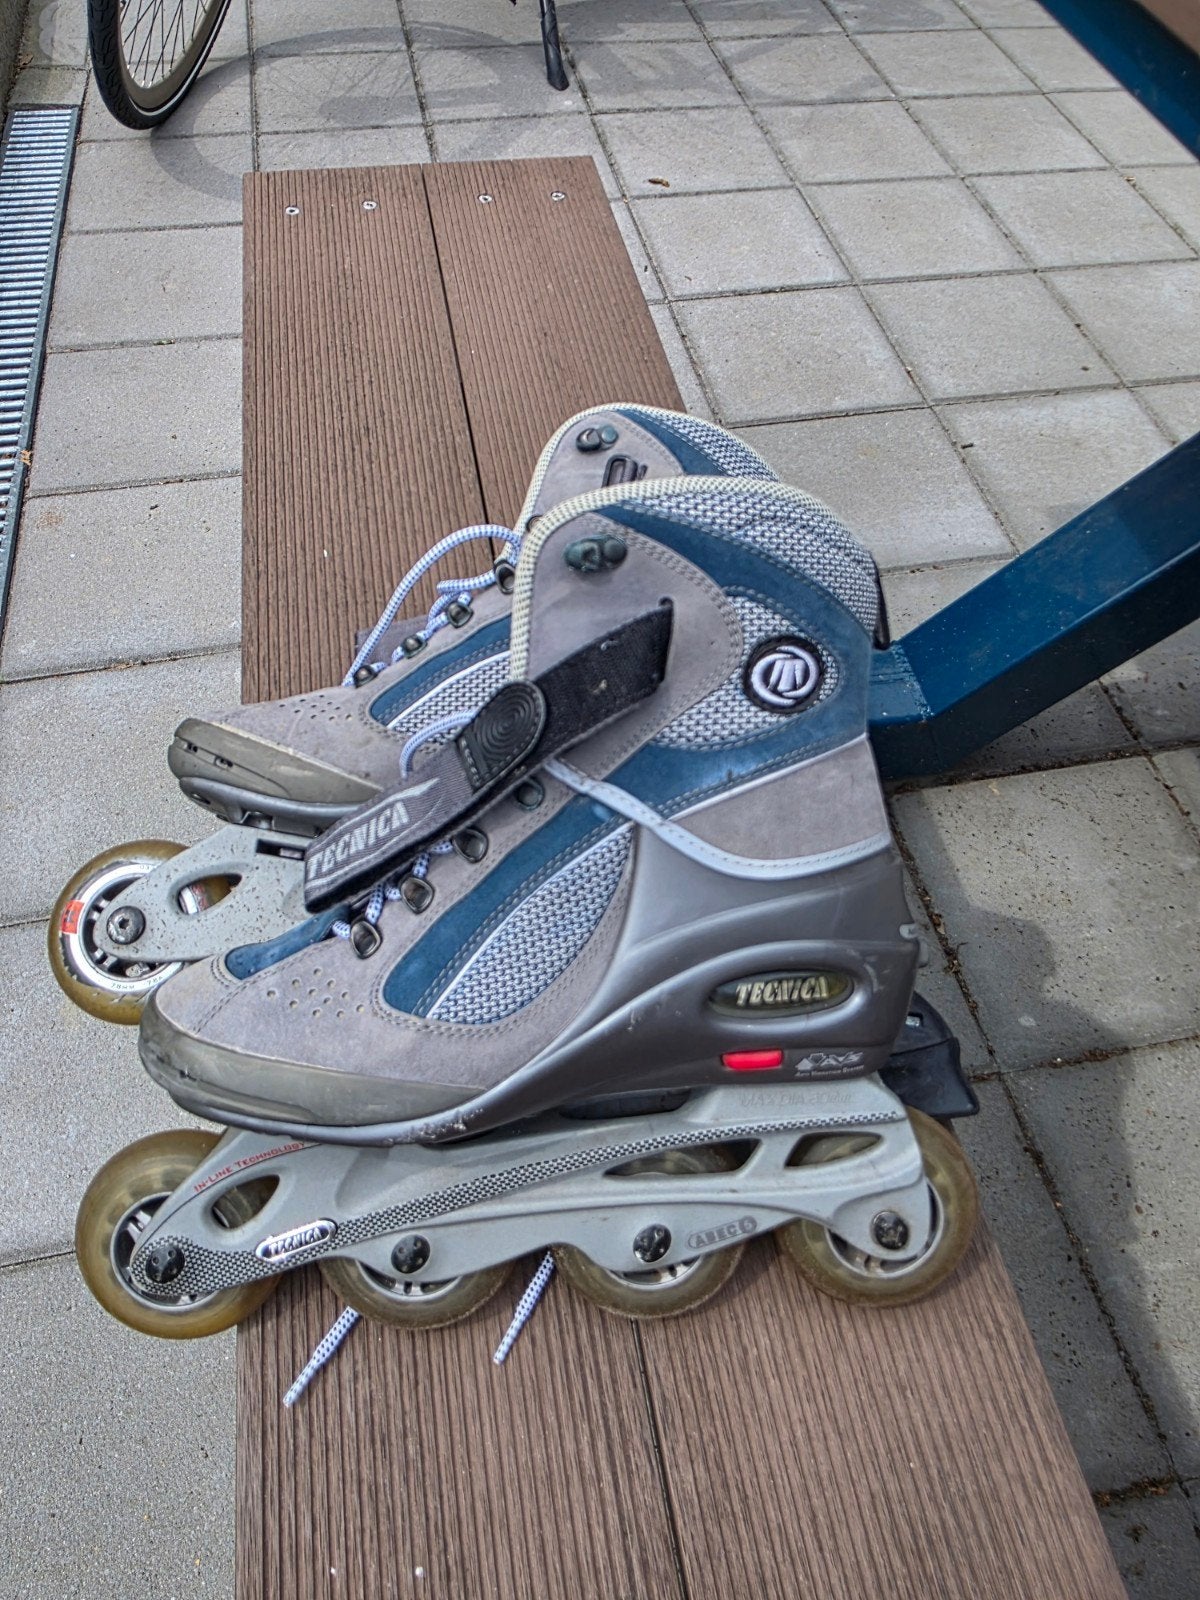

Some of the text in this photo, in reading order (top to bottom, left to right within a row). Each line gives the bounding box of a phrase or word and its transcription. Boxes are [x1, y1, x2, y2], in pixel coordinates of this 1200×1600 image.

[307, 801, 410, 878] TECNICA
[736, 976, 830, 1006] TECNICA
[194, 1142, 305, 1193] IN-LINE TECHNOLOGY
[268, 1227, 323, 1255] TECNICA
[694, 1223, 738, 1248] ABEC
